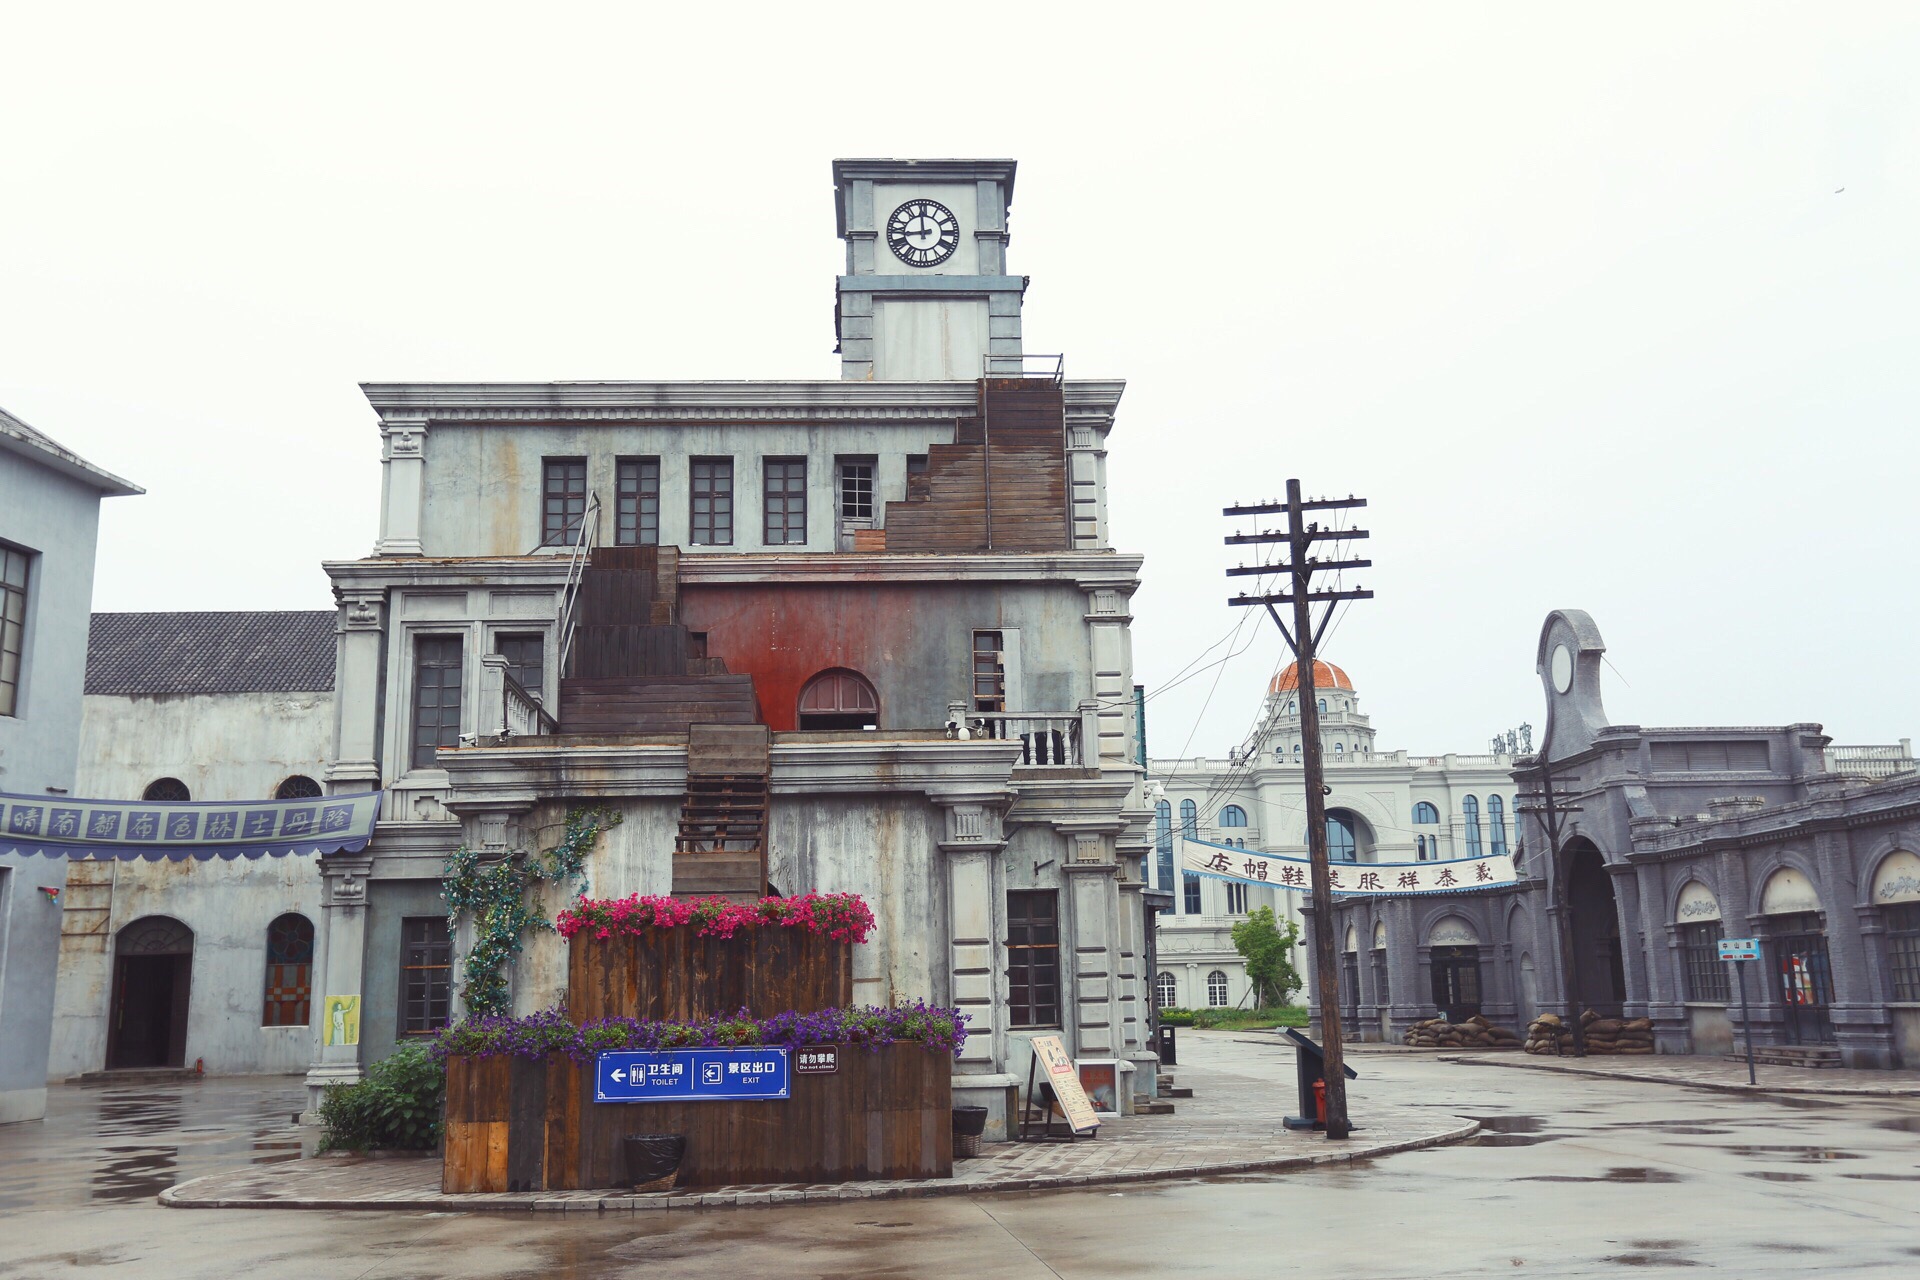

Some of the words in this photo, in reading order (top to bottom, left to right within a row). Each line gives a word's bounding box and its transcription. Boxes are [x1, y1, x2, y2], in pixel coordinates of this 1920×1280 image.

[799, 1053, 835, 1064] 请勿攀爬
[647, 1063, 683, 1076] 卫生间
[728, 1061, 775, 1074] 景区出口
[651, 1078, 679, 1086] TOILET
[742, 1076, 760, 1084] EXIT
